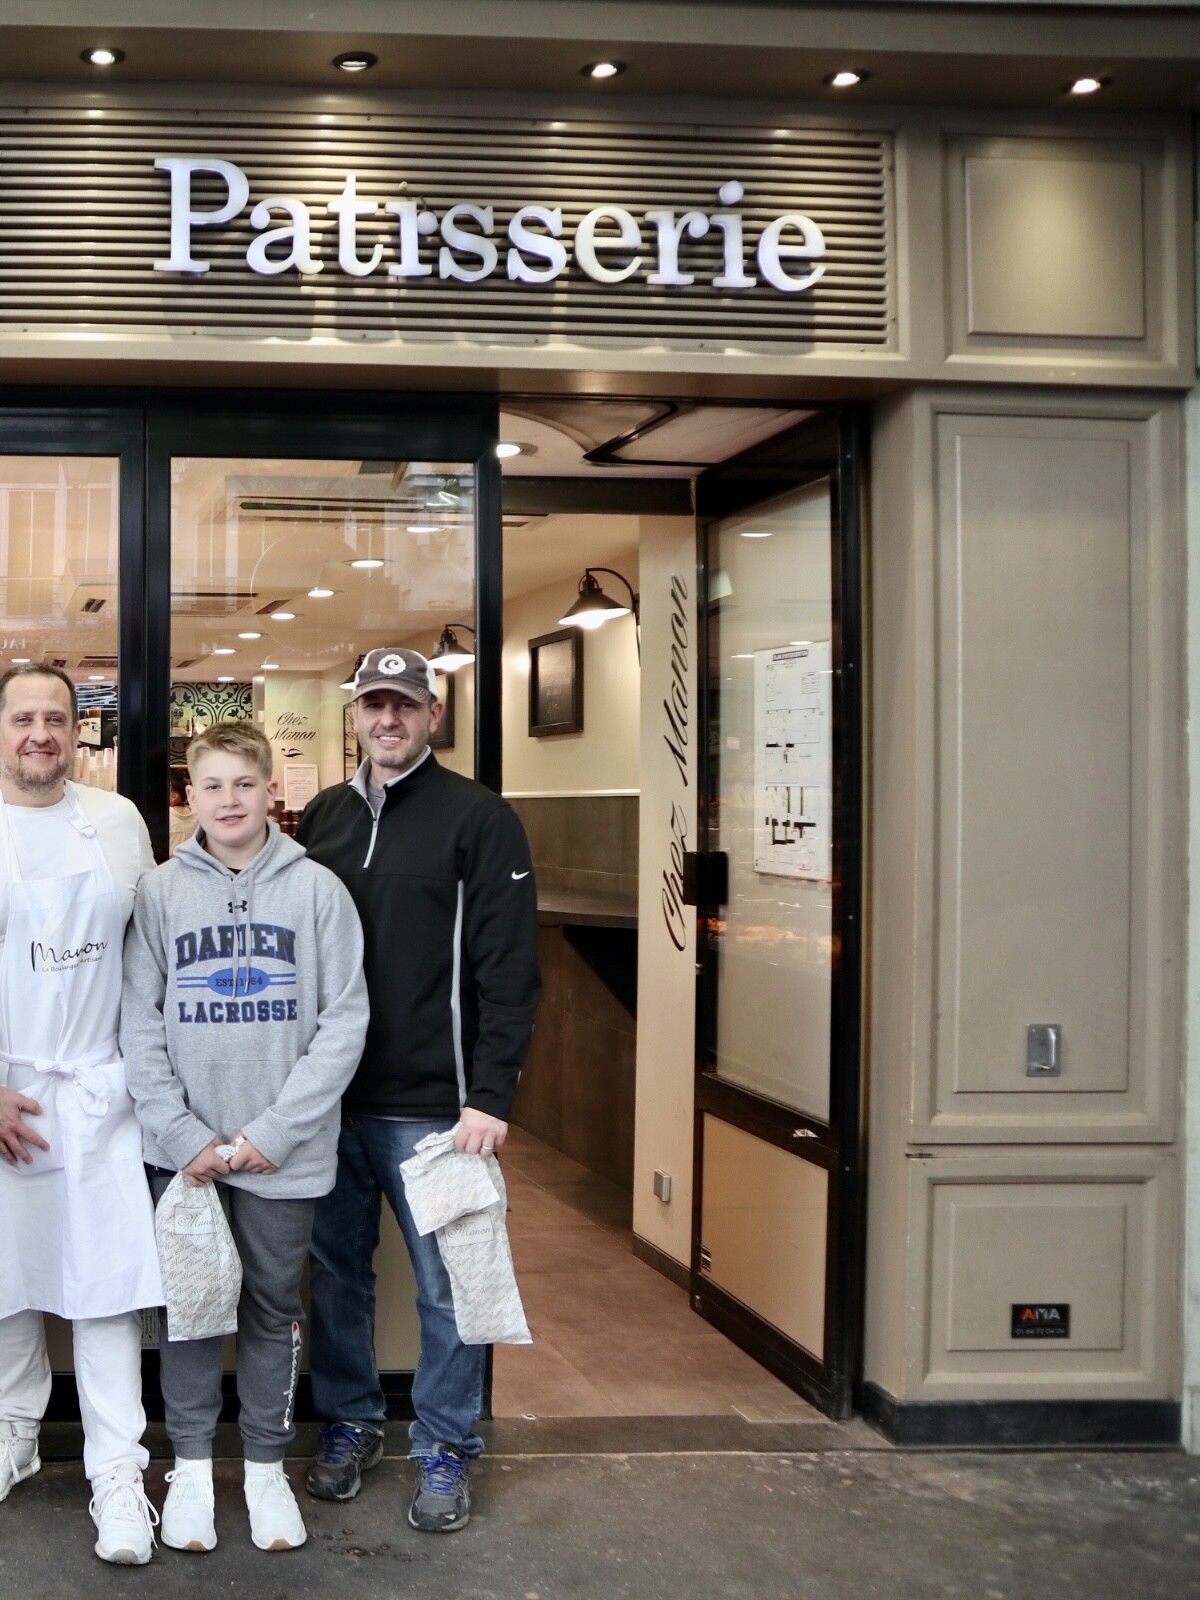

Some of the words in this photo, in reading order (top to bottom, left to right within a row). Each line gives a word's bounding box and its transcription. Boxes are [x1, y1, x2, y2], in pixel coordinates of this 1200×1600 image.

[153, 157, 827, 292] Patisserie
[662, 571, 689, 786] Manon
[269, 727, 317, 741] Manon
[276, 711, 309, 726] Chez
[661, 800, 689, 952] Chez
[30, 940, 109, 972] Manon
[174, 922, 297, 972] DARIEN
[178, 998, 298, 1024] LACROSSE
